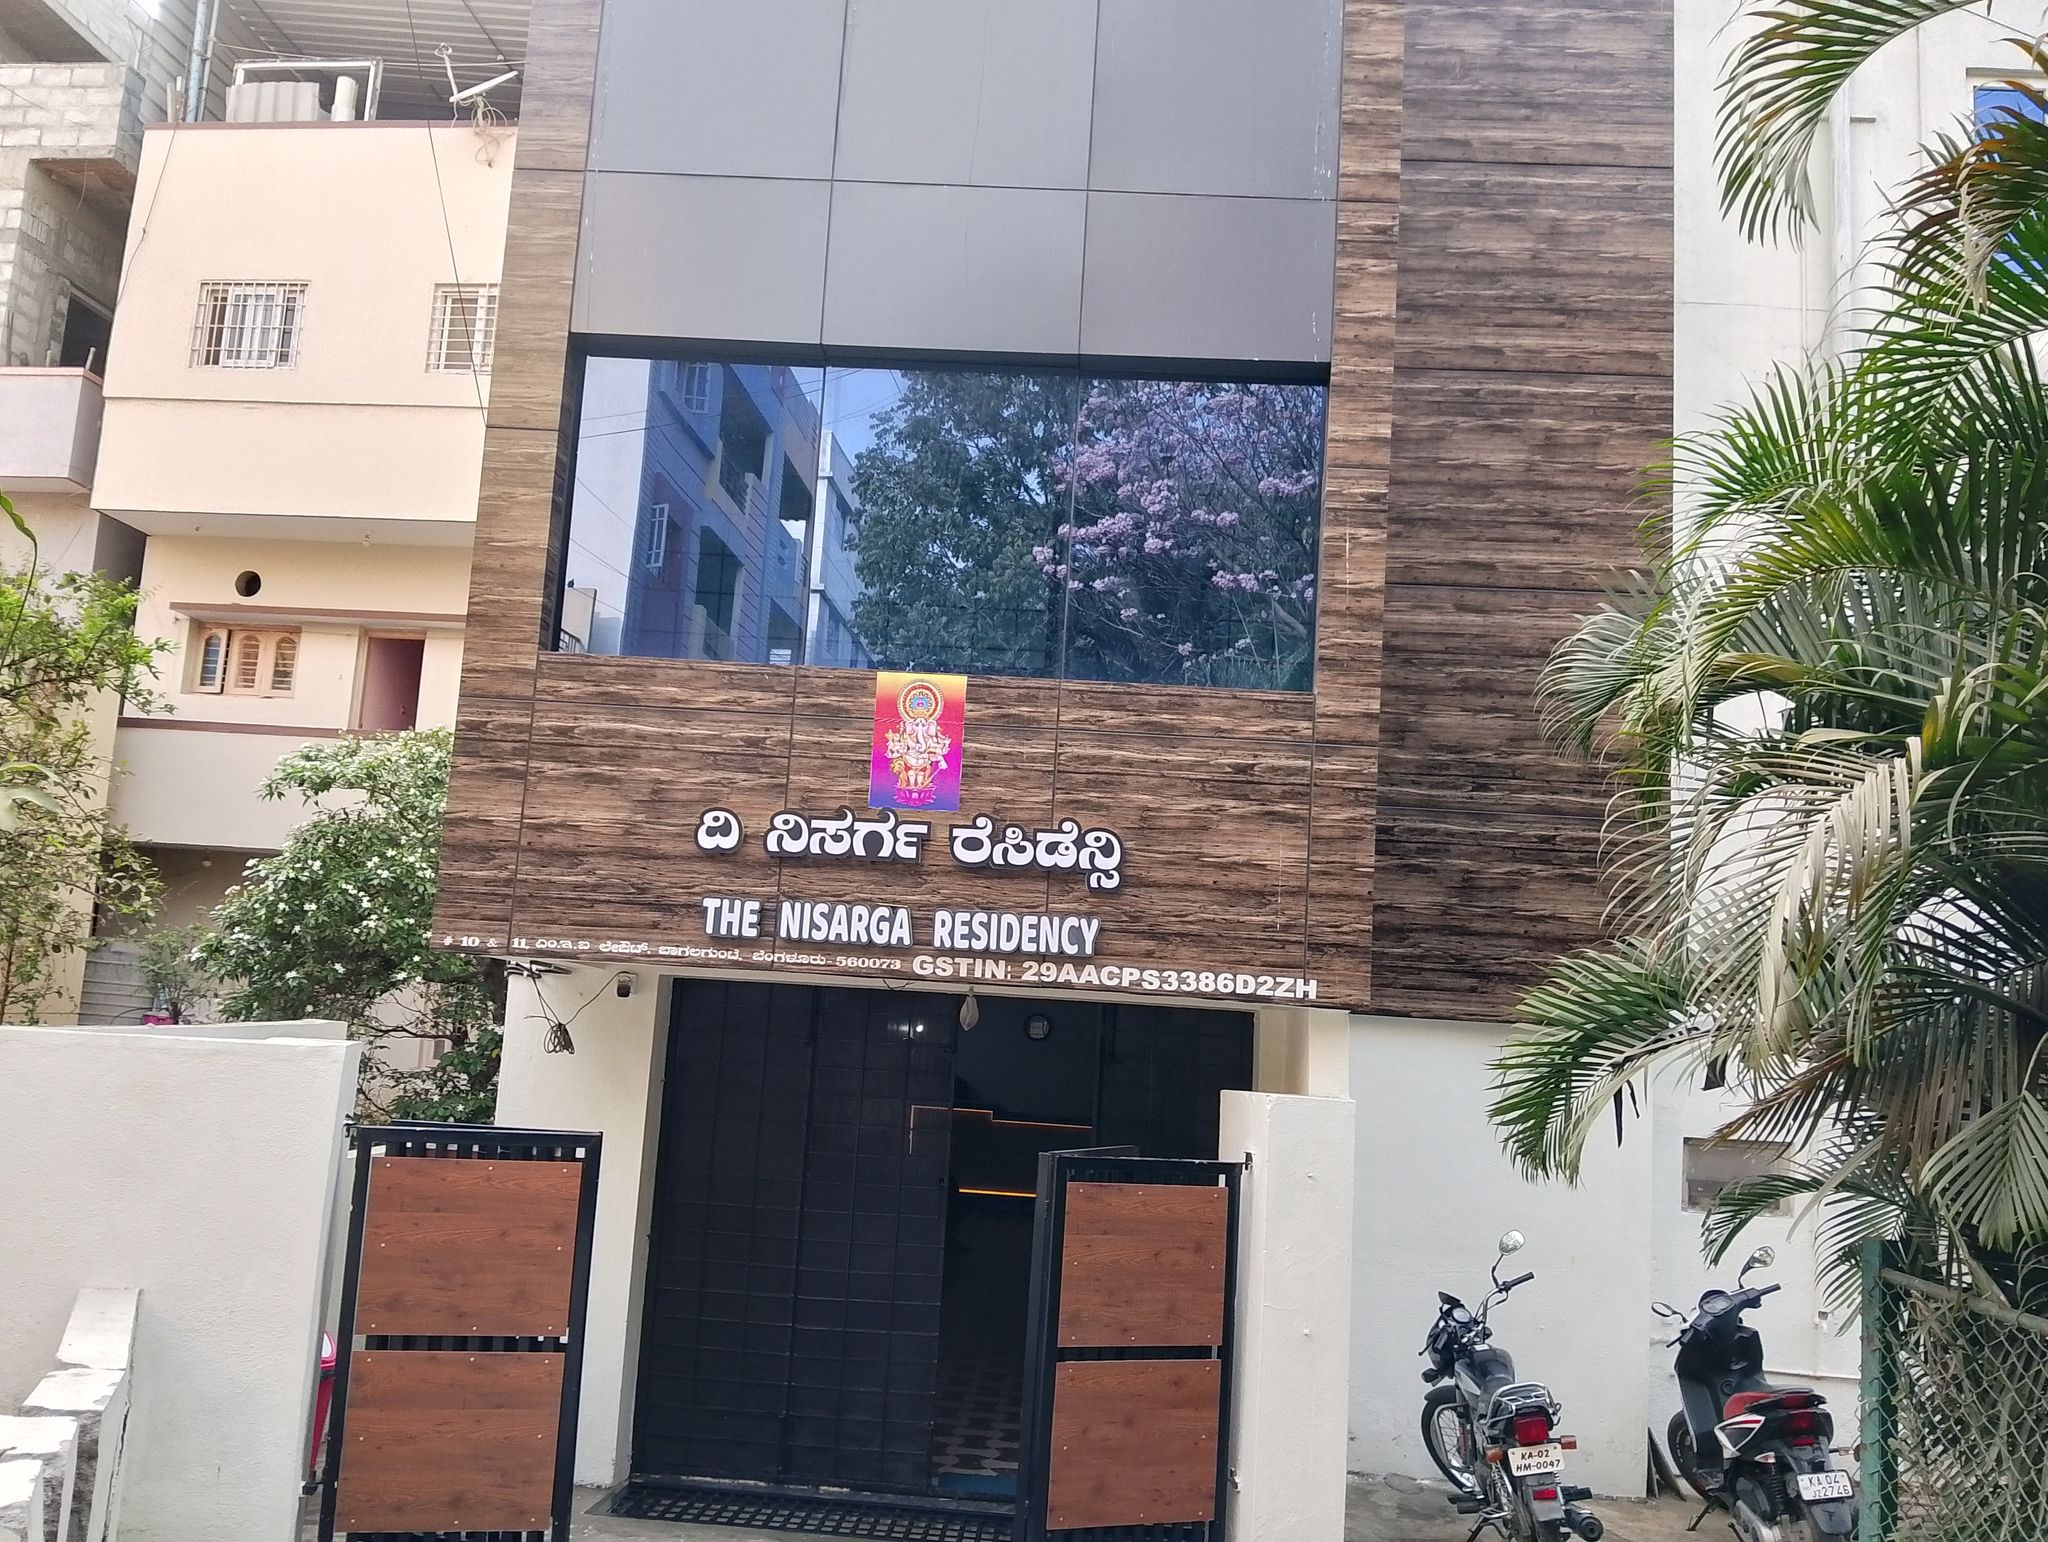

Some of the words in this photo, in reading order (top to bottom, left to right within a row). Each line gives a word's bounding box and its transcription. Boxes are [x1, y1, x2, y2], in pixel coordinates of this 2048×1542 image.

[697, 809, 741, 851] ದಿ
[766, 808, 929, 859] ನಿಸರ್ಗ
[952, 815, 1122, 889] ರೆಸಿಡೆನ್ಸಿ
[702, 897, 760, 938] THE
[779, 901, 911, 947] NISARGA
[933, 911, 1099, 955] RESIDENCY
[443, 936, 454, 946] #
[460, 936, 480, 947] 10
[486, 938, 499, 948] &
[912, 955, 1012, 981] GSTIN:
[1021, 961, 1317, 999] 29AACPS3386D2ZH
[1521, 1450, 1550, 1461] KA-02
[1516, 1459, 1560, 1472] HM-0047
[1808, 1476, 1823, 1487] KA
[1825, 1474, 1840, 1485] 04
